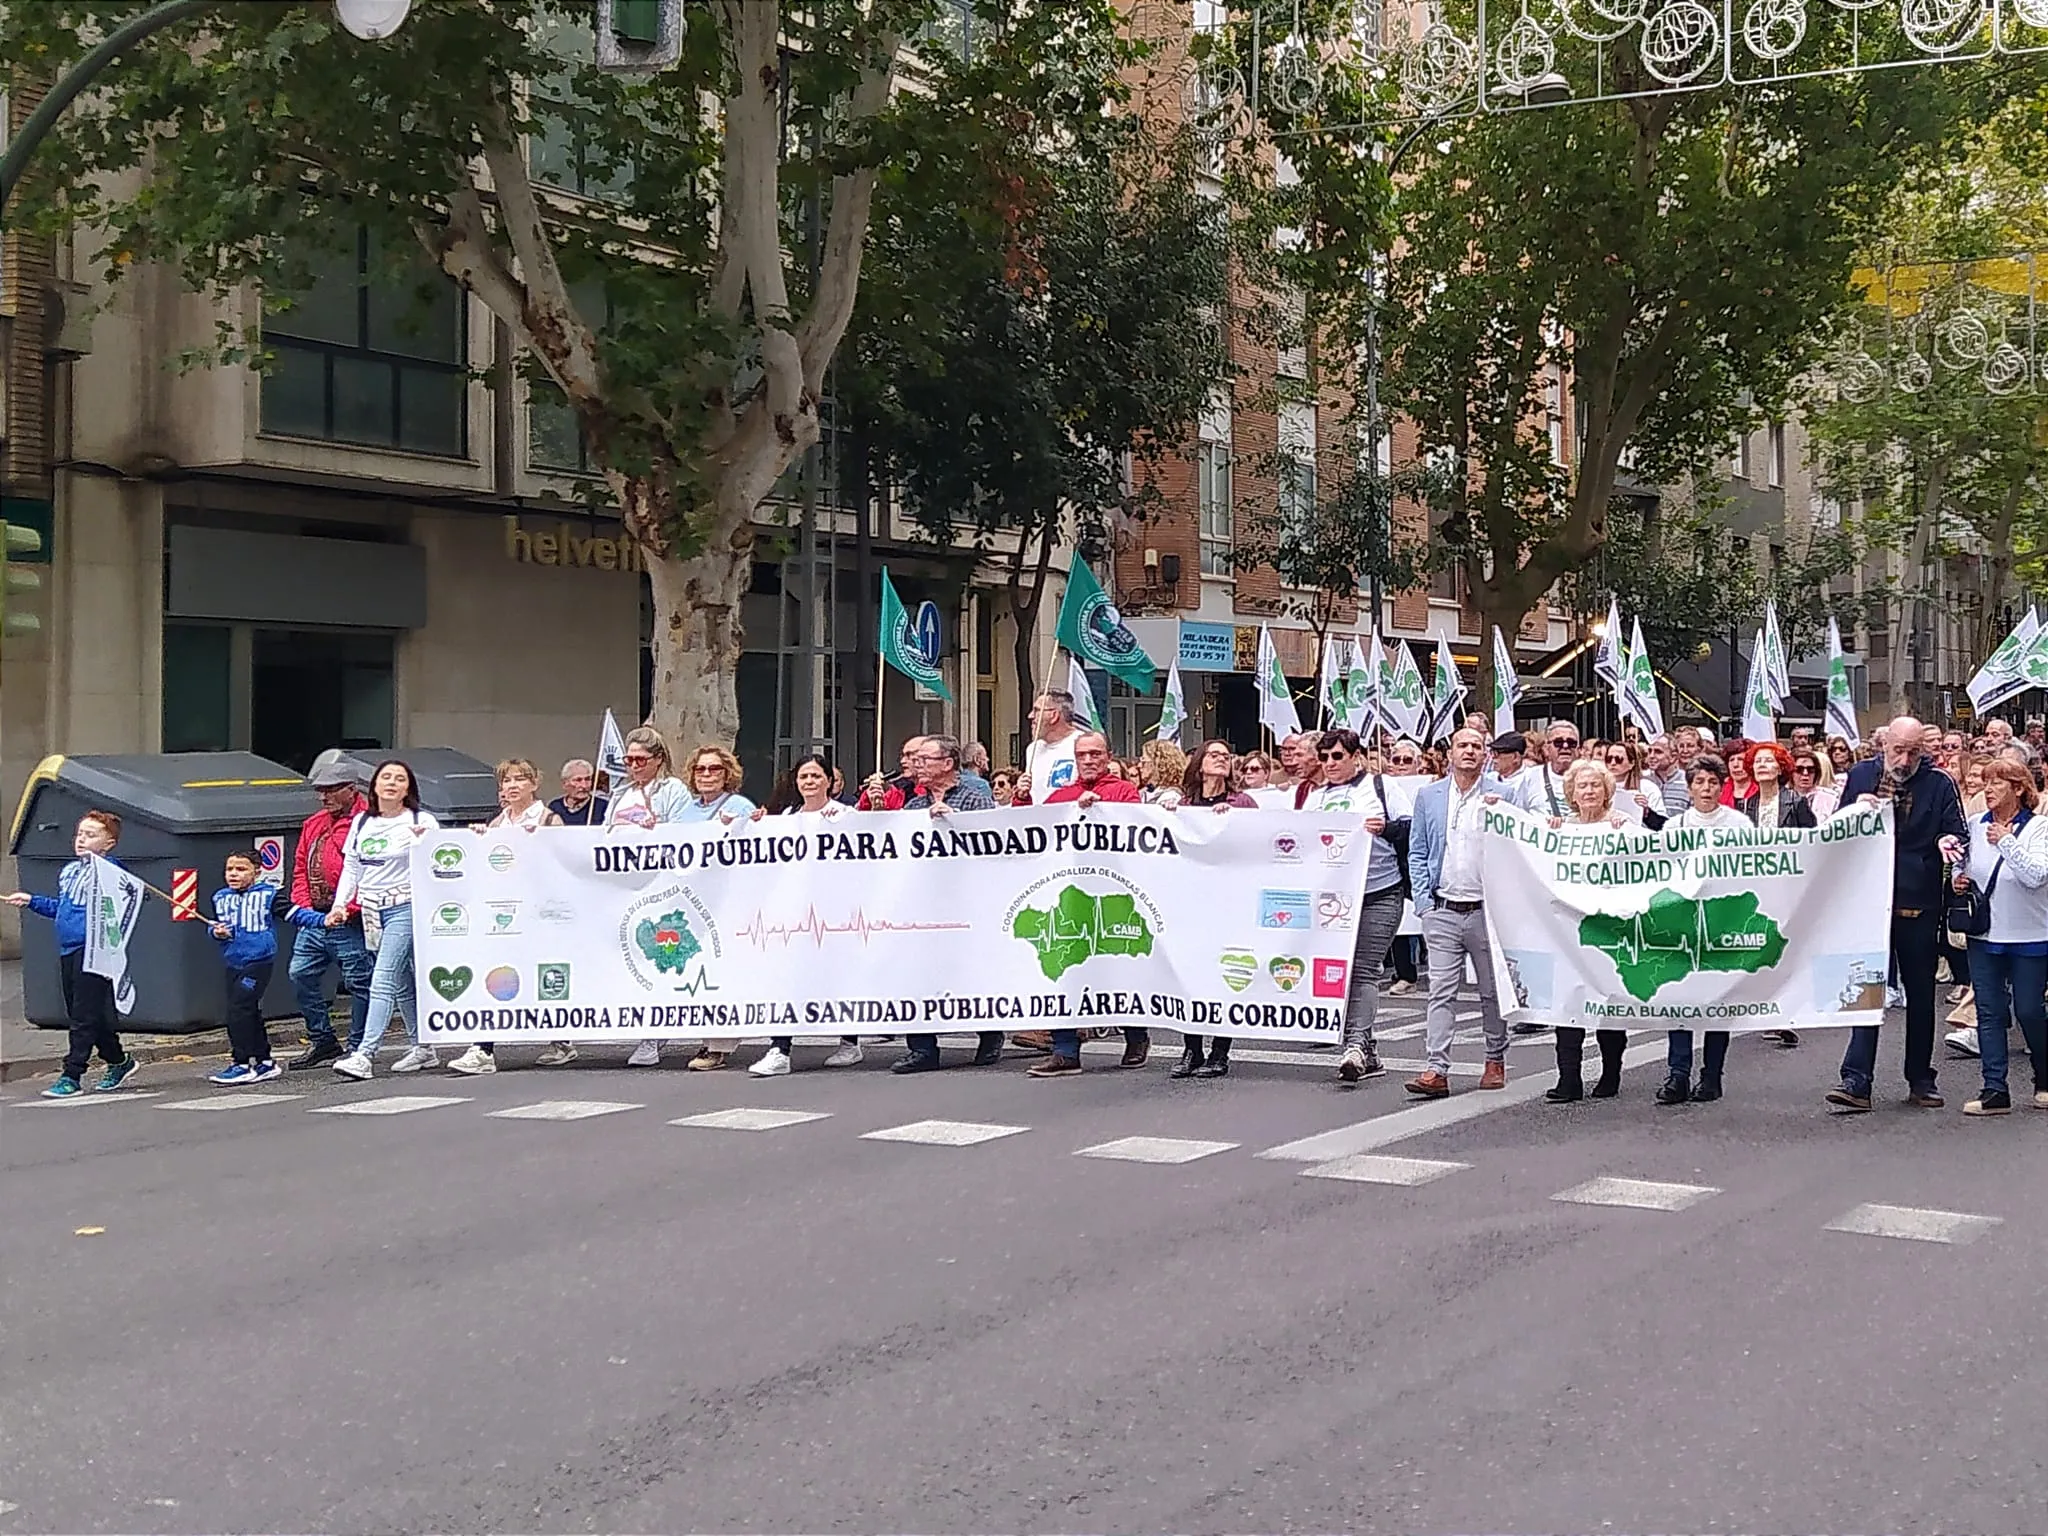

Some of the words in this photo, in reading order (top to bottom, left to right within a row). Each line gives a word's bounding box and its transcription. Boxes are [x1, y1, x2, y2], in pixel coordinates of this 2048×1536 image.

[594, 843, 694, 873] DINERO
[700, 832, 807, 867] PÚBLICO
[816, 833, 898, 861] PARA
[910, 826, 1048, 859] SANIDAD
[1056, 814, 1180, 855] PÚBLICA
[1484, 811, 1515, 839] POR
[1519, 821, 1539, 848] LA
[1544, 831, 1629, 856] DEFENSA
[1634, 834, 1659, 854] DE
[1666, 829, 1708, 852] UNA
[1712, 827, 1802, 847] SANIDAD
[1556, 862, 1582, 884] DE
[1586, 861, 1671, 885] CALIDAD
[1677, 858, 1688, 880] Y
[1695, 851, 1804, 878] UNIVERSAL
[1002, 876, 1050, 932] COORDINADORA
[1052, 867, 1096, 881] ANDALUZA
[1099, 868, 1110, 877] DE
[1111, 872, 1139, 894] MAREAS
[1139, 893, 1164, 933] BLANCAS
[1113, 924, 1142, 937] CAMB
[1721, 932, 1767, 948] CAMB
[428, 1007, 612, 1032] COORDINADORA
[618, 1005, 645, 1028] EN
[650, 1003, 742, 1027] DEFENSA
[744, 1004, 769, 1025] DE
[770, 1001, 798, 1024] LA
[805, 999, 917, 1023] SANIDAD
[924, 992, 1024, 1021] PÚBLICA
[1030, 996, 1072, 1017] DEL
[1077, 988, 1145, 1016] ÁREA
[1151, 997, 1186, 1021] SUR
[1191, 1001, 1222, 1024] DE
[1228, 1003, 1341, 1032] CORDOBA
[1585, 1001, 1636, 1017] MAREA
[1640, 1003, 1701, 1018] BLANCA
[1706, 1002, 1780, 1018] CÓRDOBA
